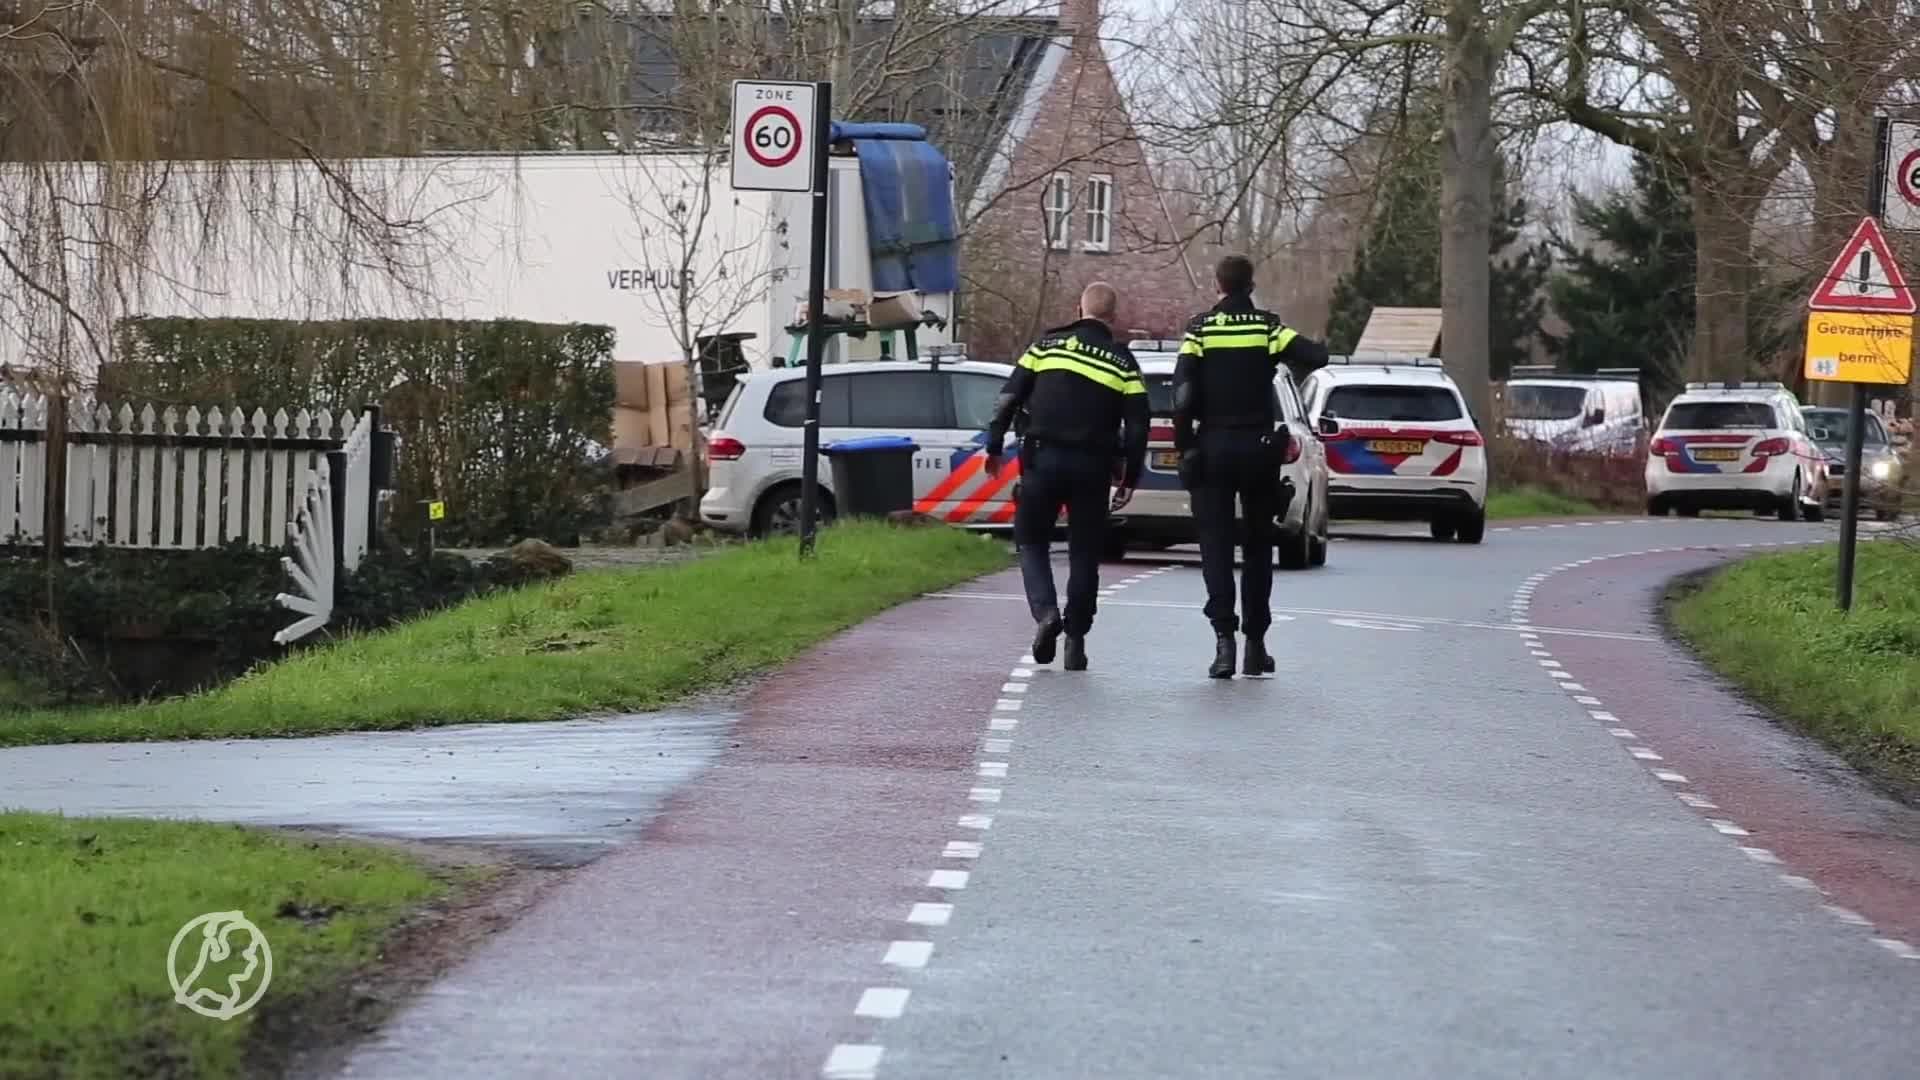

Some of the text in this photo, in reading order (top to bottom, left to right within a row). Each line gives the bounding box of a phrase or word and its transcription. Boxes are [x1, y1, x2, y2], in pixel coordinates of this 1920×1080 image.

[755, 89, 793, 101] ZONE
[755, 126, 791, 148] 60
[1910, 166, 1920, 189] 6
[607, 269, 696, 290] VERHUUR
[1817, 322, 1903, 340] Gevaarlijke
[1838, 352, 1878, 364] berm
[914, 458, 943, 470] TIE
